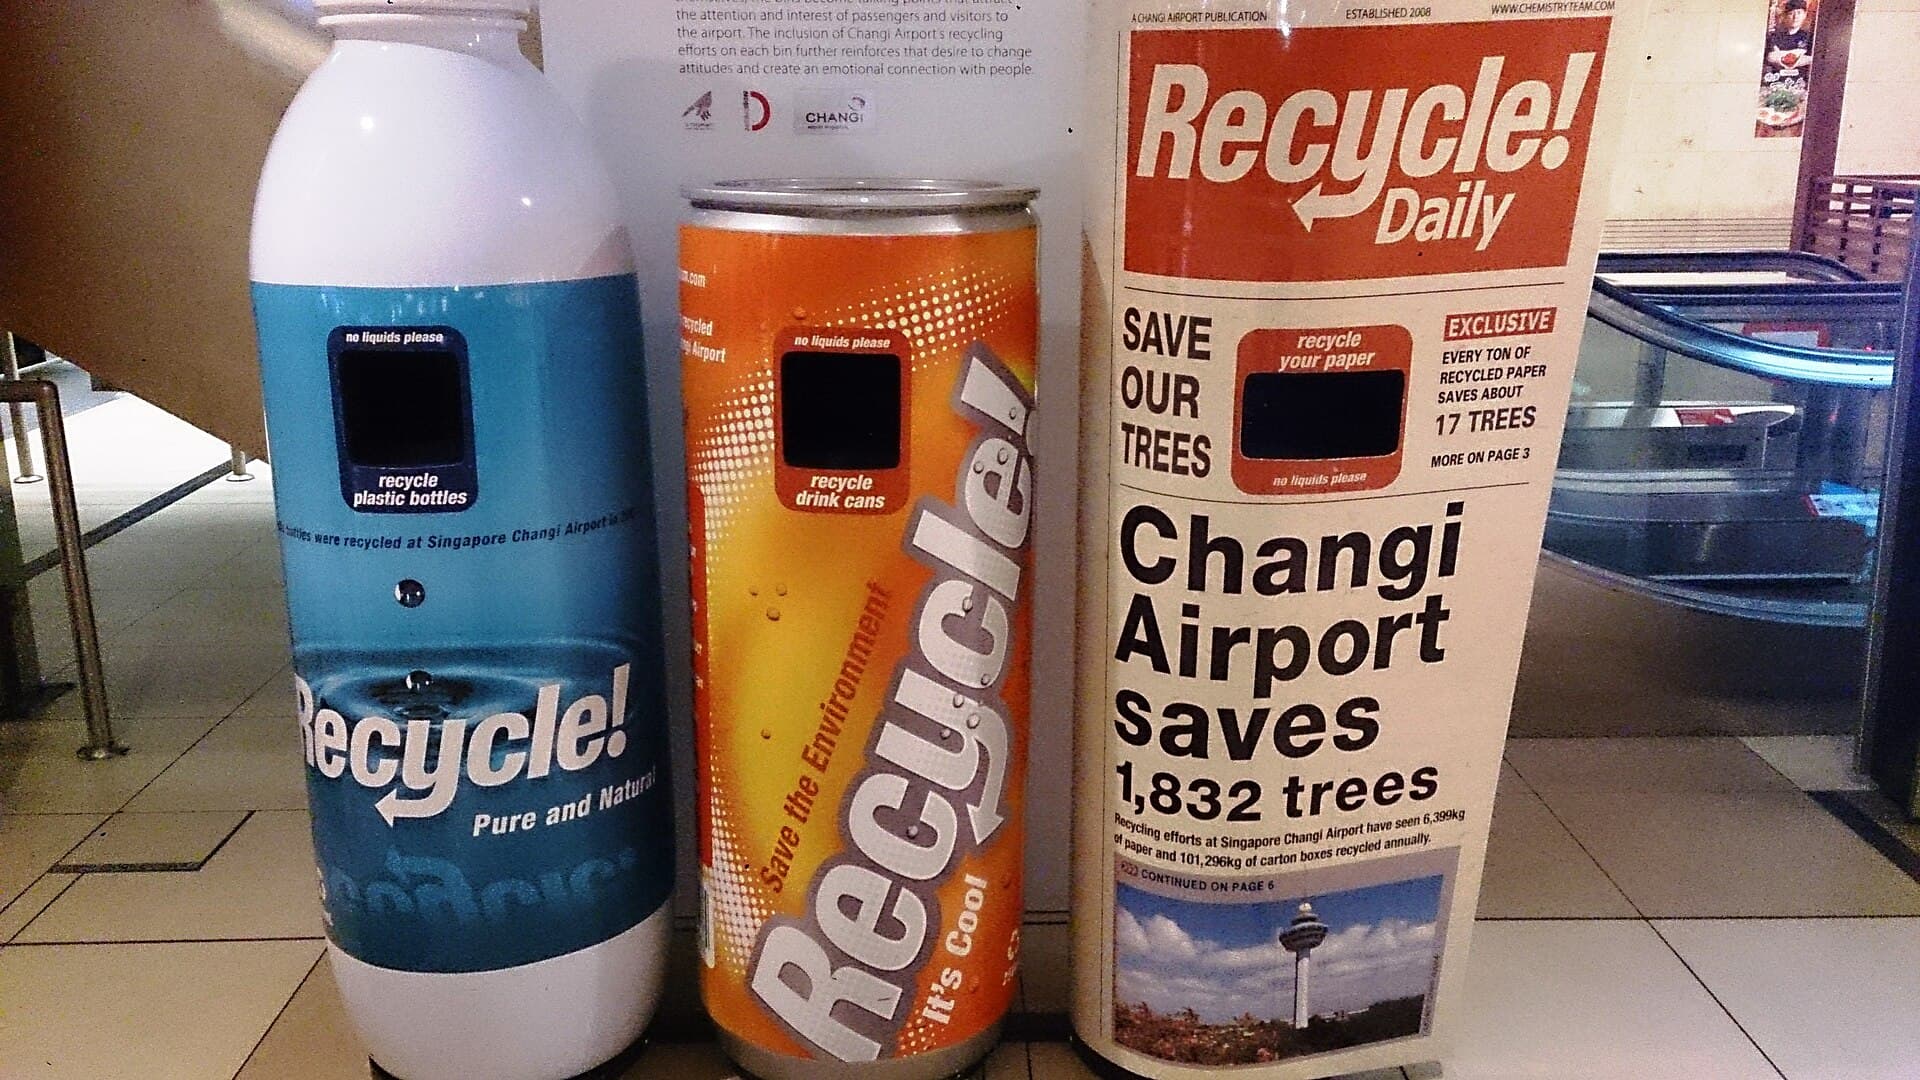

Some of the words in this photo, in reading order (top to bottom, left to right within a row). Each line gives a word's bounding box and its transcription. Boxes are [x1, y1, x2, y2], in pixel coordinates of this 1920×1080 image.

[676, 9, 697, 21] the
[700, 9, 757, 21] attention
[760, 9, 783, 21] and
[786, 9, 833, 21] interest
[836, 9, 849, 21] of
[852, 11, 920, 24] passengers
[923, 10, 946, 21] and
[950, 10, 992, 21] visitors
[996, 11, 1008, 21] to
[1167, 12, 1203, 22] AIRPORT
[1205, 11, 1268, 22] PUBLICATION
[1346, 8, 1408, 19] ESTABLISHED
[1409, 7, 1432, 18] 2008
[677, 26, 697, 38] the
[748, 26, 770, 39] The
[774, 26, 829, 39] inclusion
[832, 27, 845, 39] of
[847, 27, 891, 41] Changi
[949, 28, 1003, 42] recycling
[678, 44, 717, 57] efforts
[720, 47, 737, 57] on
[740, 45, 769, 57] each
[773, 45, 793, 57] bin
[796, 44, 838, 57] further
[841, 45, 900, 57] reinforces
[904, 46, 927, 57] that
[931, 46, 968, 57] desire
[971, 47, 984, 57] to
[987, 46, 1032, 60] change
[679, 63, 733, 74] attitudes
[736, 63, 760, 74] and
[763, 64, 801, 74] create
[804, 65, 820, 75] an
[822, 63, 884, 75] emotional
[887, 63, 956, 75] connection
[960, 63, 986, 75] with
[1136, 51, 1597, 231] Recycle!
[1375, 180, 1516, 251] Daily
[1122, 306, 1213, 361] SAVE
[1448, 311, 1551, 337] EXCLUSIVE
[346, 332, 360, 342] no
[361, 331, 401, 346] liquids
[403, 331, 444, 346] please
[795, 336, 809, 346] no
[811, 335, 850, 349] liquids
[852, 336, 891, 349] please
[1296, 331, 1361, 351] recycle
[692, 341, 727, 363] Airport
[1279, 354, 1321, 371] your
[1325, 350, 1376, 370] paper
[1442, 348, 1482, 364] EVERY
[1487, 347, 1511, 361] TON
[1515, 346, 1531, 359] OF
[1440, 368, 1503, 384] RECYCLED
[1506, 365, 1547, 379] PAPER
[1121, 366, 1201, 419] OUR
[1438, 389, 1478, 403] SAVES
[1481, 385, 1524, 400] ABOUT
[1436, 413, 1461, 436] 17
[1468, 406, 1537, 432] TREES
[1120, 422, 1212, 479] TREES
[1431, 453, 1465, 468] MORE
[1467, 452, 1484, 464] ON
[1487, 448, 1521, 462] PAGE
[1522, 448, 1530, 460] 3
[378, 472, 438, 490] recycle
[810, 474, 873, 492] recycle
[1273, 476, 1288, 487] no
[1290, 472, 1329, 488] liquids
[1331, 470, 1367, 486] please
[353, 490, 406, 509] plastic
[409, 488, 468, 506] bottles
[796, 492, 841, 508] drink
[843, 494, 886, 509] cans
[314, 533, 340, 546] were
[344, 536, 402, 550] recycled
[407, 536, 422, 549] at
[427, 532, 507, 550] Singapore
[511, 524, 561, 543] Changi
[564, 516, 607, 536] Airport
[1120, 501, 1465, 601] Changi
[1114, 593, 1451, 699] Airport
[801, 577, 892, 774] Environment
[751, 356, 1035, 1062] Recycle!
[1114, 689, 1381, 761] saves
[294, 663, 631, 828] Recycle!
[784, 774, 819, 825] the
[1116, 760, 1263, 821] 1,832
[1282, 766, 1439, 819] trees
[473, 813, 537, 837] Pure
[545, 794, 591, 826] and
[1114, 812, 1161, 841] Recycling
[1163, 830, 1202, 847] efforts
[1206, 837, 1217, 848] at
[1221, 836, 1281, 851] Singapore
[1284, 829, 1323, 845] Changi
[1326, 823, 1364, 840] Airport
[1366, 820, 1392, 834] have
[1395, 816, 1420, 829] seen
[1423, 809, 1466, 825] 6,399kg
[760, 825, 801, 894] Save
[1114, 833, 1123, 845] of
[1125, 839, 1153, 857] paper
[1155, 849, 1177, 862] and
[1181, 852, 1242, 870] 101,296kg
[1245, 855, 1257, 867] of
[1260, 853, 1297, 867] carton
[1300, 848, 1333, 862] boxes
[1336, 839, 1381, 857] recycled
[1384, 833, 1432, 849] annually.
[1141, 869, 1207, 891] CONTINUED
[1210, 880, 1228, 892] ON
[1232, 879, 1263, 892] PAGE
[1267, 879, 1275, 890] 6
[922, 967, 963, 1025] It's
[945, 873, 988, 957] Cool
